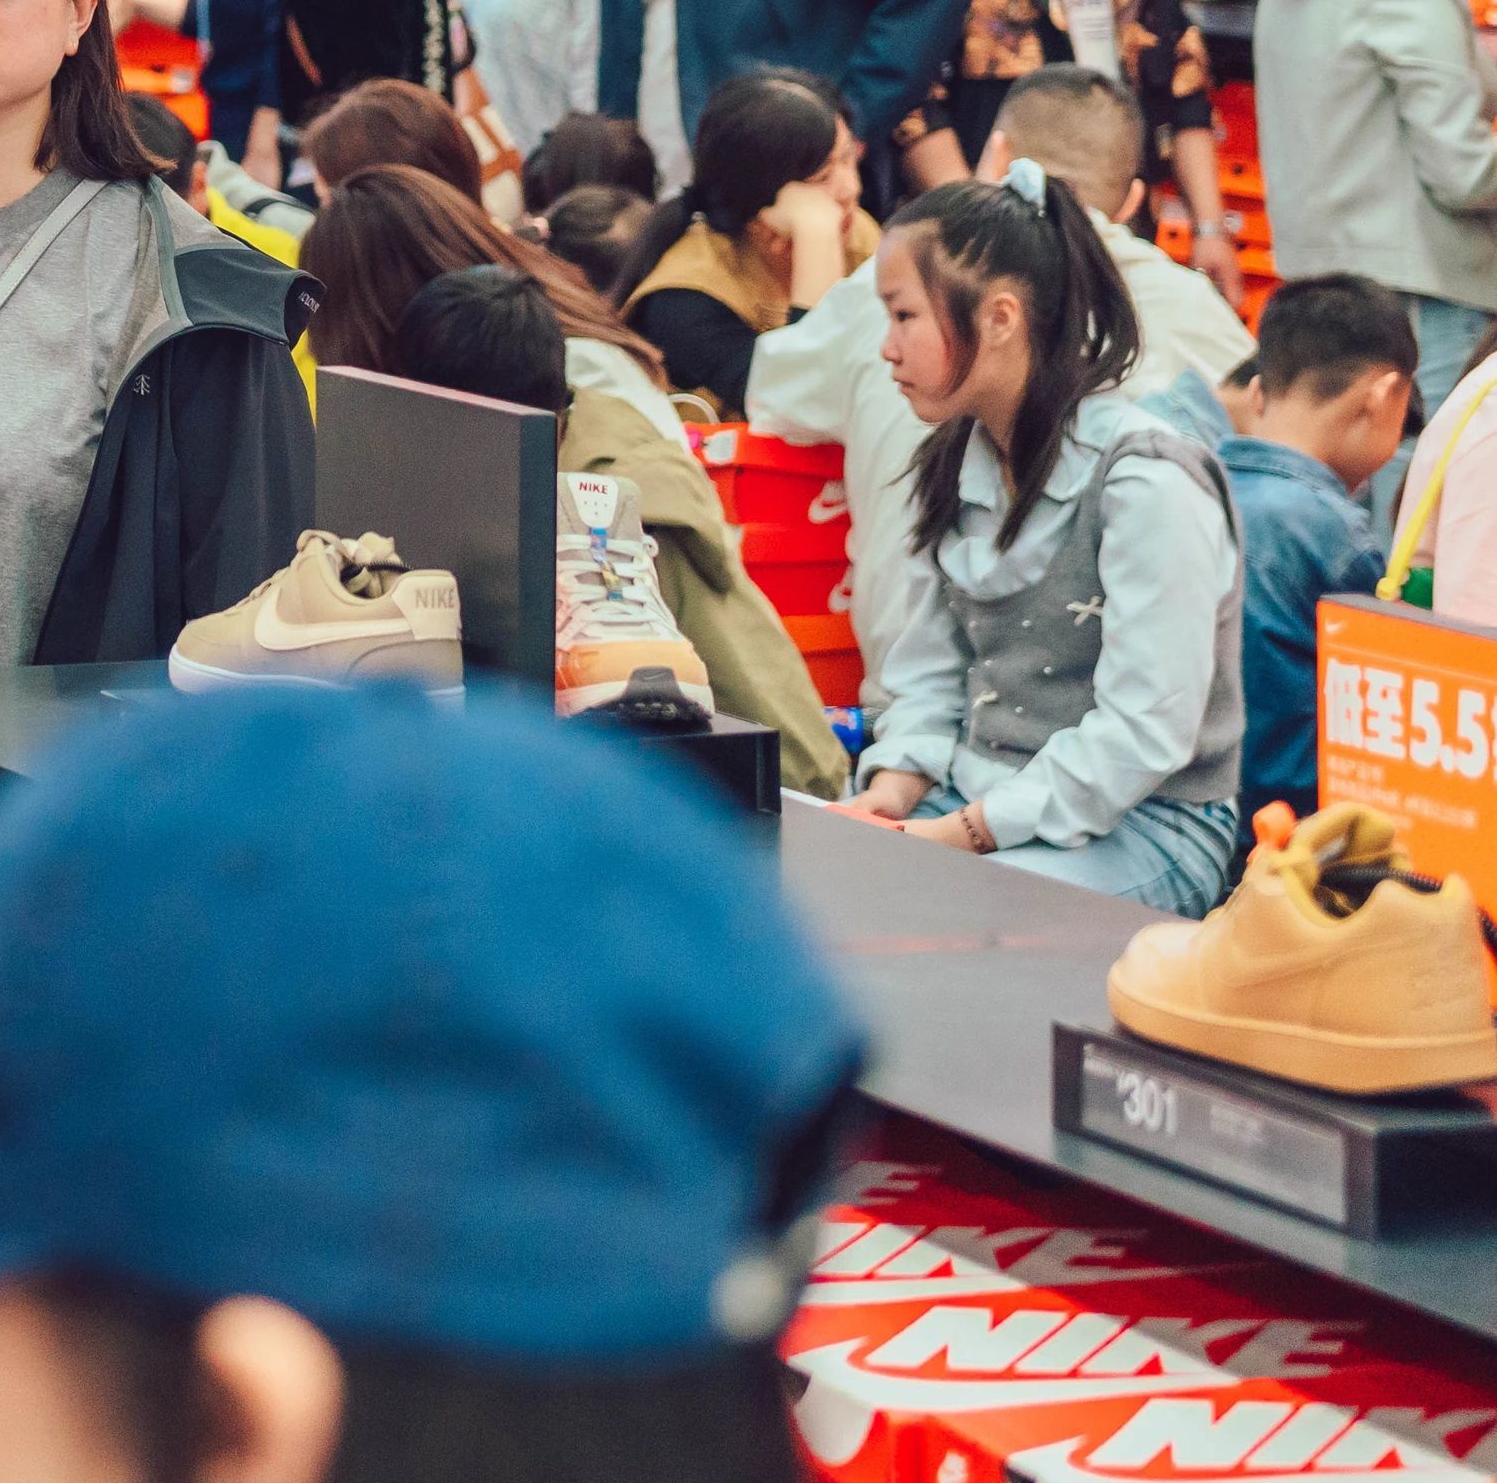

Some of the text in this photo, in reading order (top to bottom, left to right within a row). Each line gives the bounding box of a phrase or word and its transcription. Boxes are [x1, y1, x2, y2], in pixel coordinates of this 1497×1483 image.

[579, 481, 608, 495] NIKE
[415, 587, 456, 609] NIKE
[1323, 657, 1497, 782] 低至5.5
[865, 1305, 1368, 1378] NIKE
